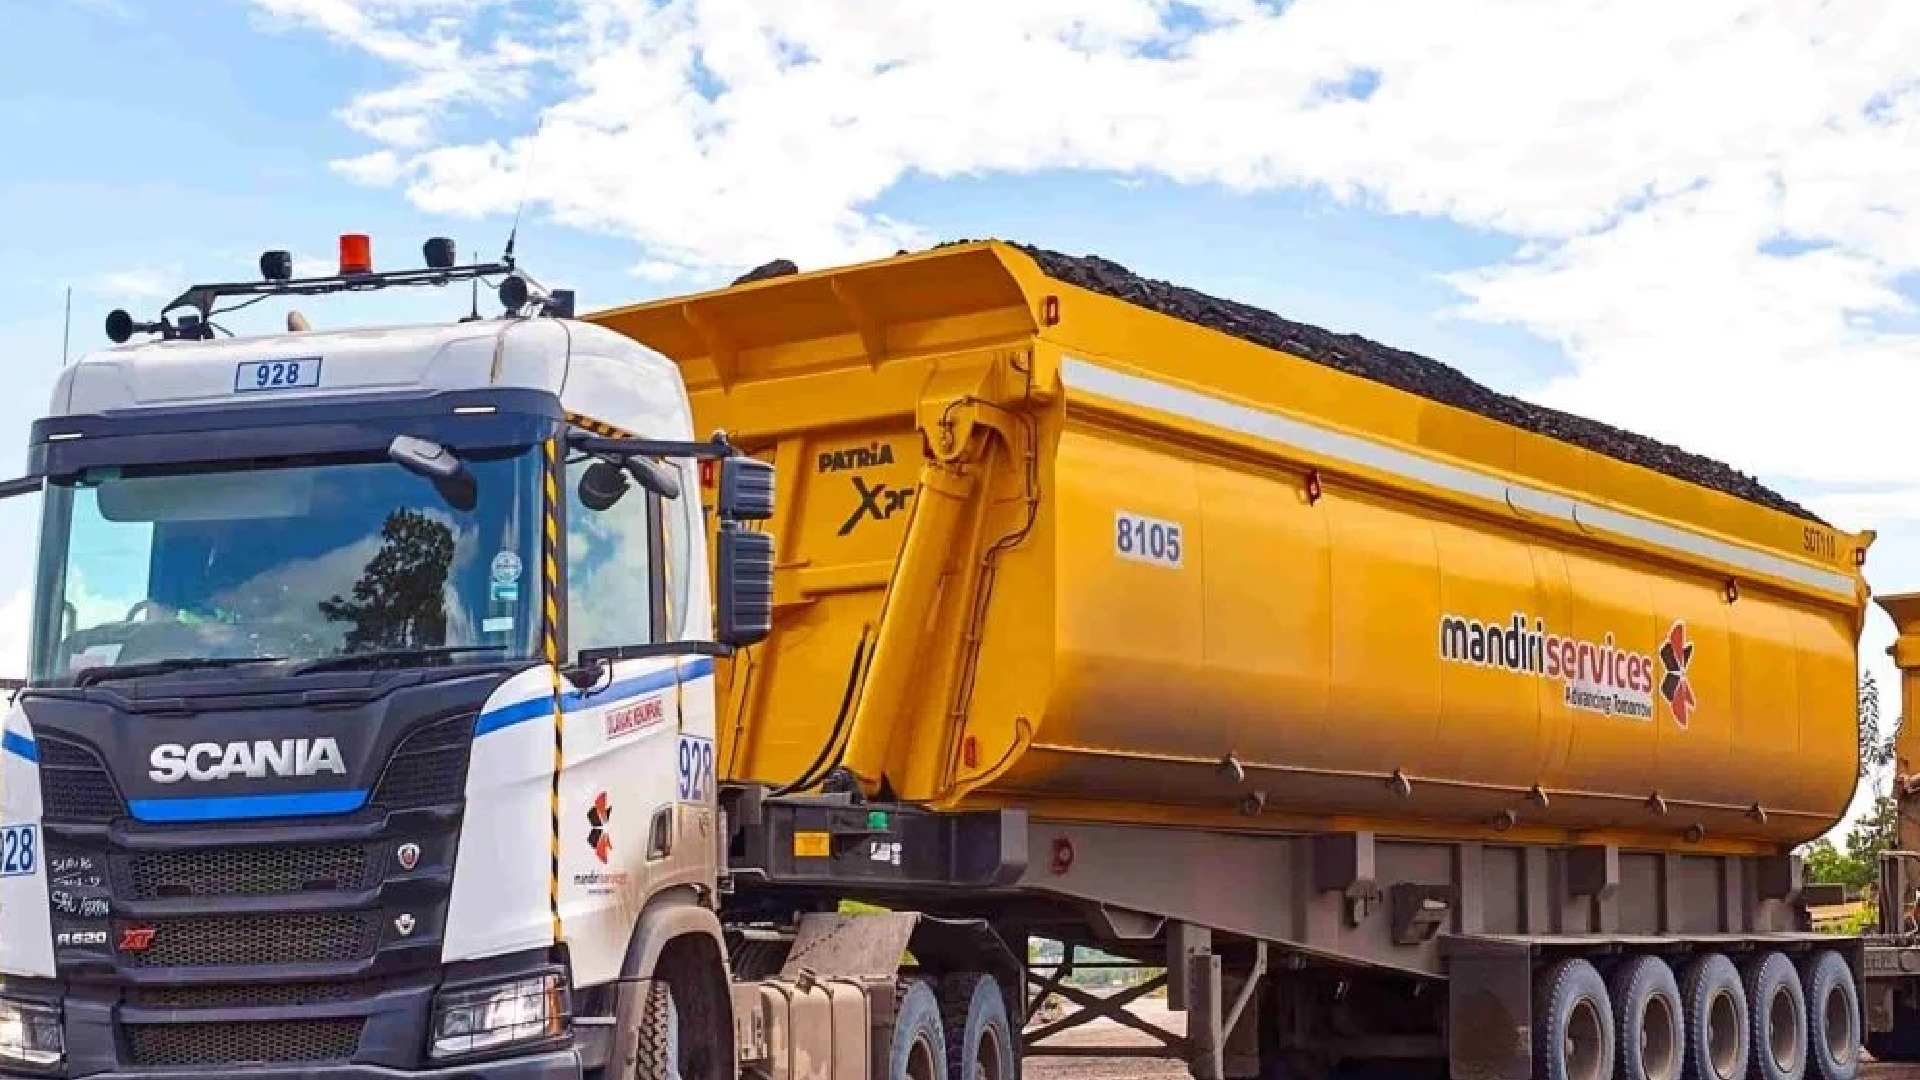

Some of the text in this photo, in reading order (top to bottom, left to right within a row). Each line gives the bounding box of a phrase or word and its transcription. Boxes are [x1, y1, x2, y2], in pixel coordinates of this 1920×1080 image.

[256, 363, 299, 386] 928
[1117, 518, 1179, 562] 8105
[1441, 614, 1653, 694] mandiriservices
[149, 737, 347, 784] SCANIA
[679, 738, 713, 801] 928
[0, 828, 33, 871] 28
